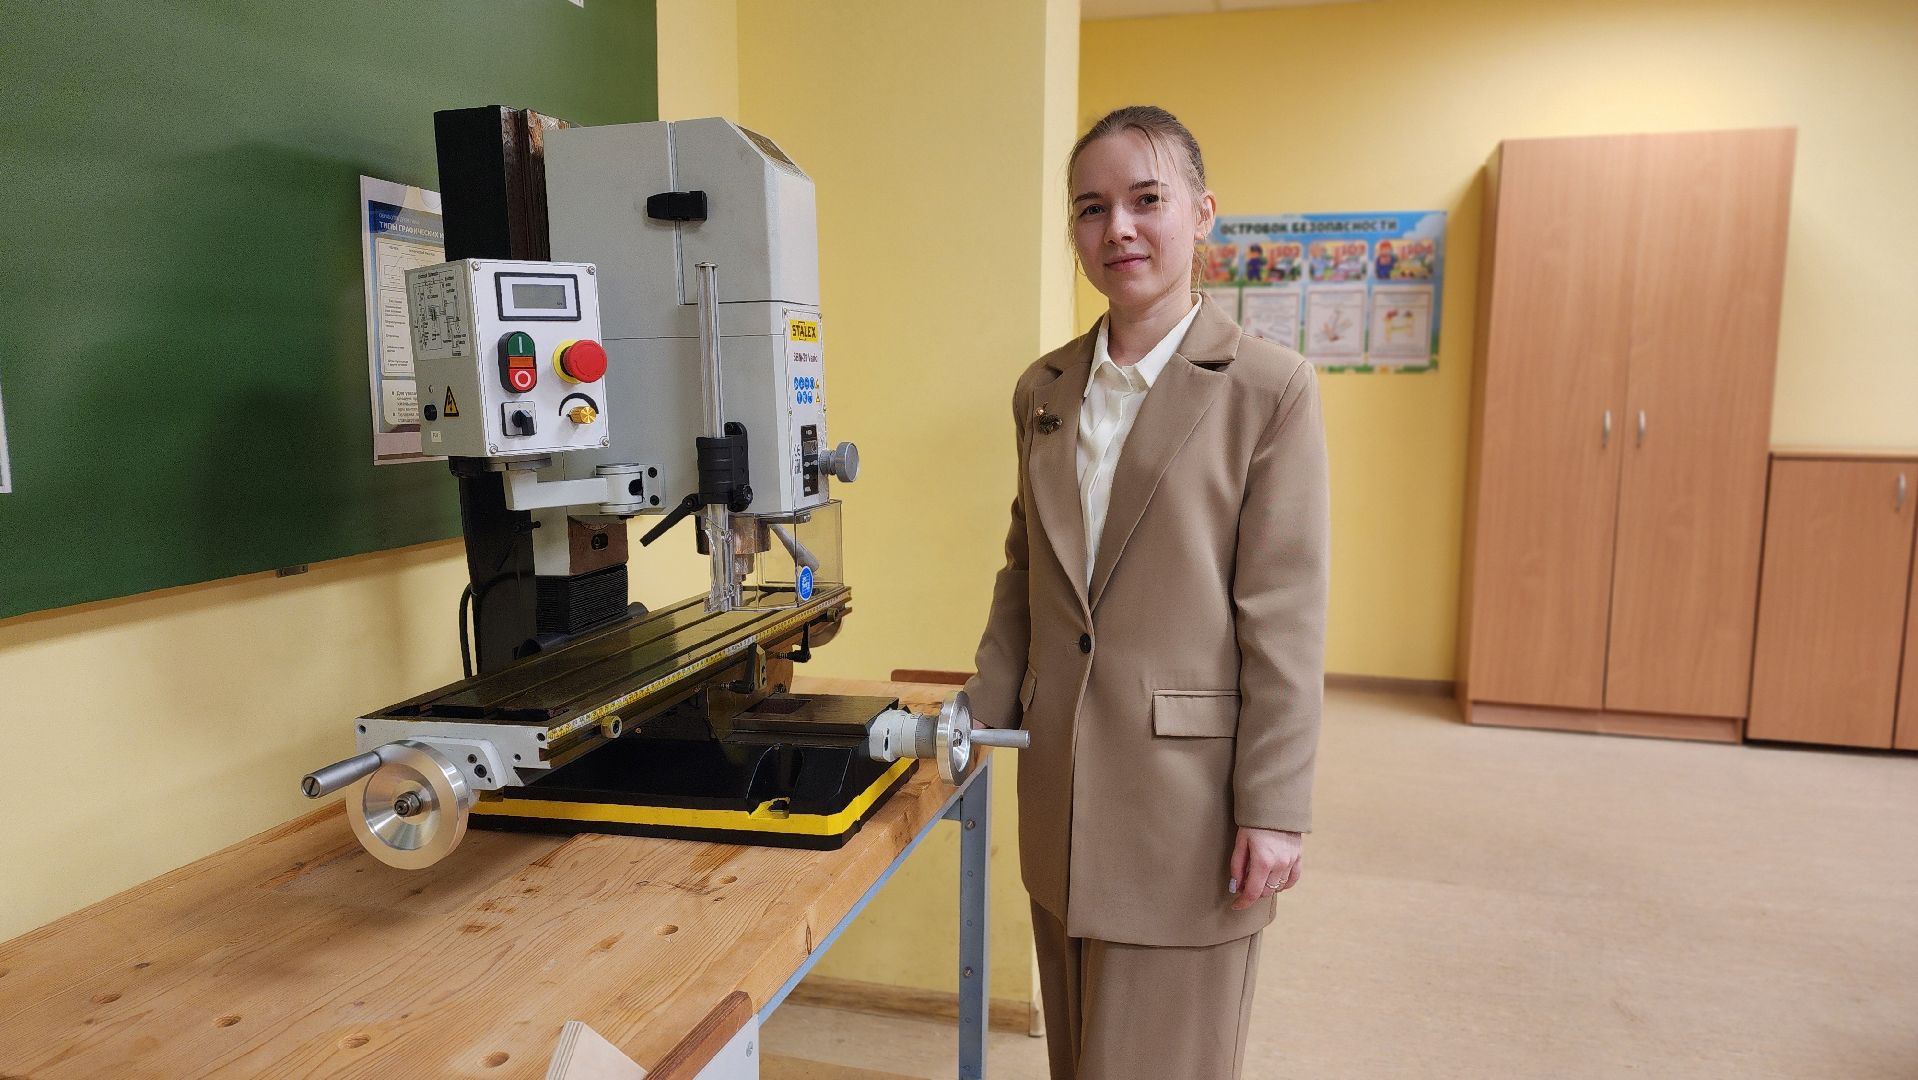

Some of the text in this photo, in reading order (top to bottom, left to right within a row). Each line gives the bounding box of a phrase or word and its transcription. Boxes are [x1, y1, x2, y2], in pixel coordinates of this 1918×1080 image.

[379, 221, 397, 231] ТИПЫ
[399, 225, 439, 238] ГРАФИЧЕСКИХ
[1220, 220, 1396, 235] ОСТРОВОК БЕЗОПАСНОСТИ
[791, 324, 817, 338] STALEX
